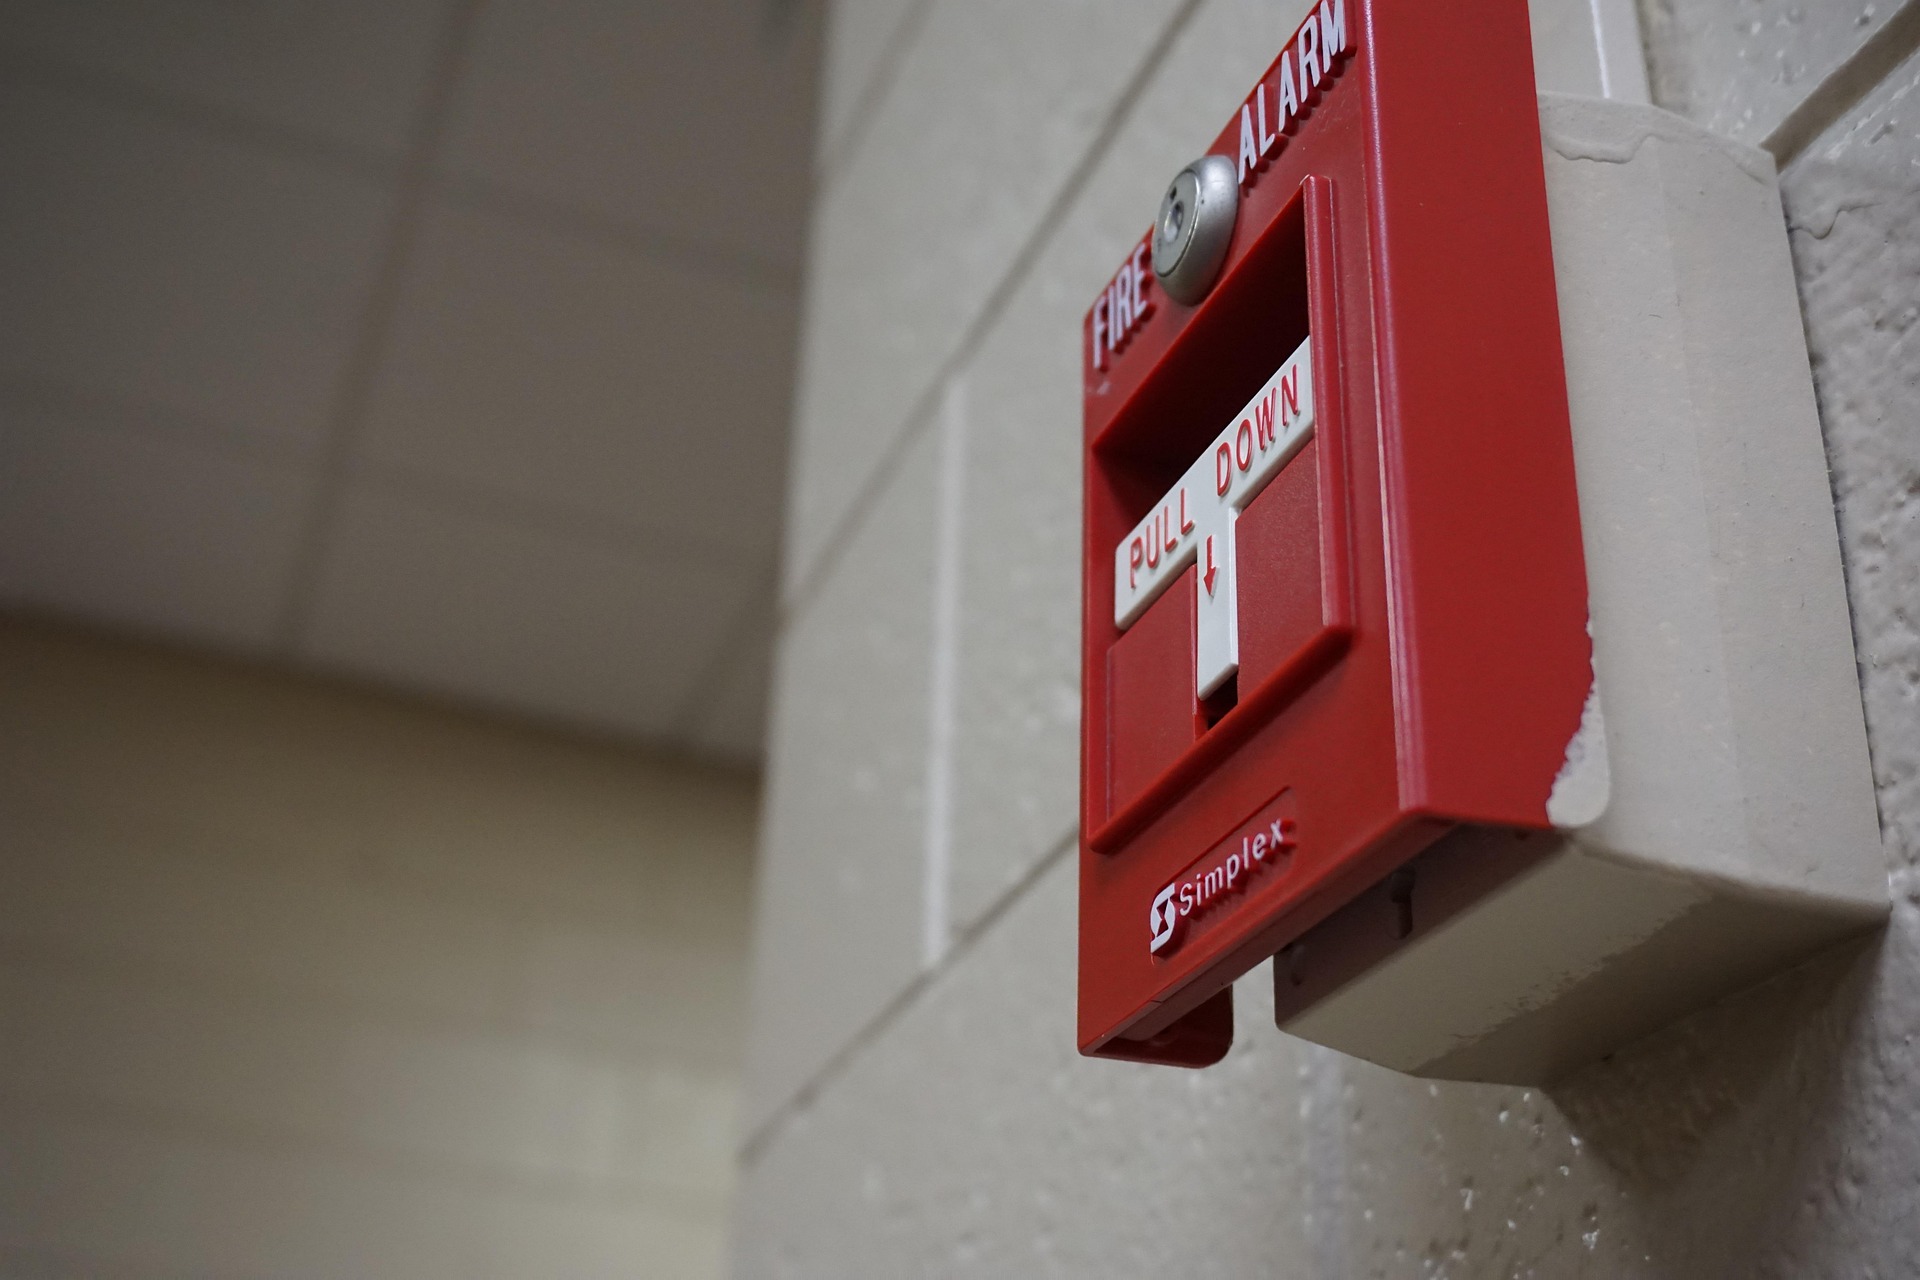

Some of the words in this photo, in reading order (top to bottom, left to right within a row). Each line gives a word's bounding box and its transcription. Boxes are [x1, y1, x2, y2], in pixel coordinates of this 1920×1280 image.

[1092, 242, 1148, 369] FIRE
[1238, 0, 1347, 184] ALARM
[1130, 488, 1194, 589] PULL
[1216, 364, 1299, 496] DOWN
[1180, 818, 1284, 916] Simplex
